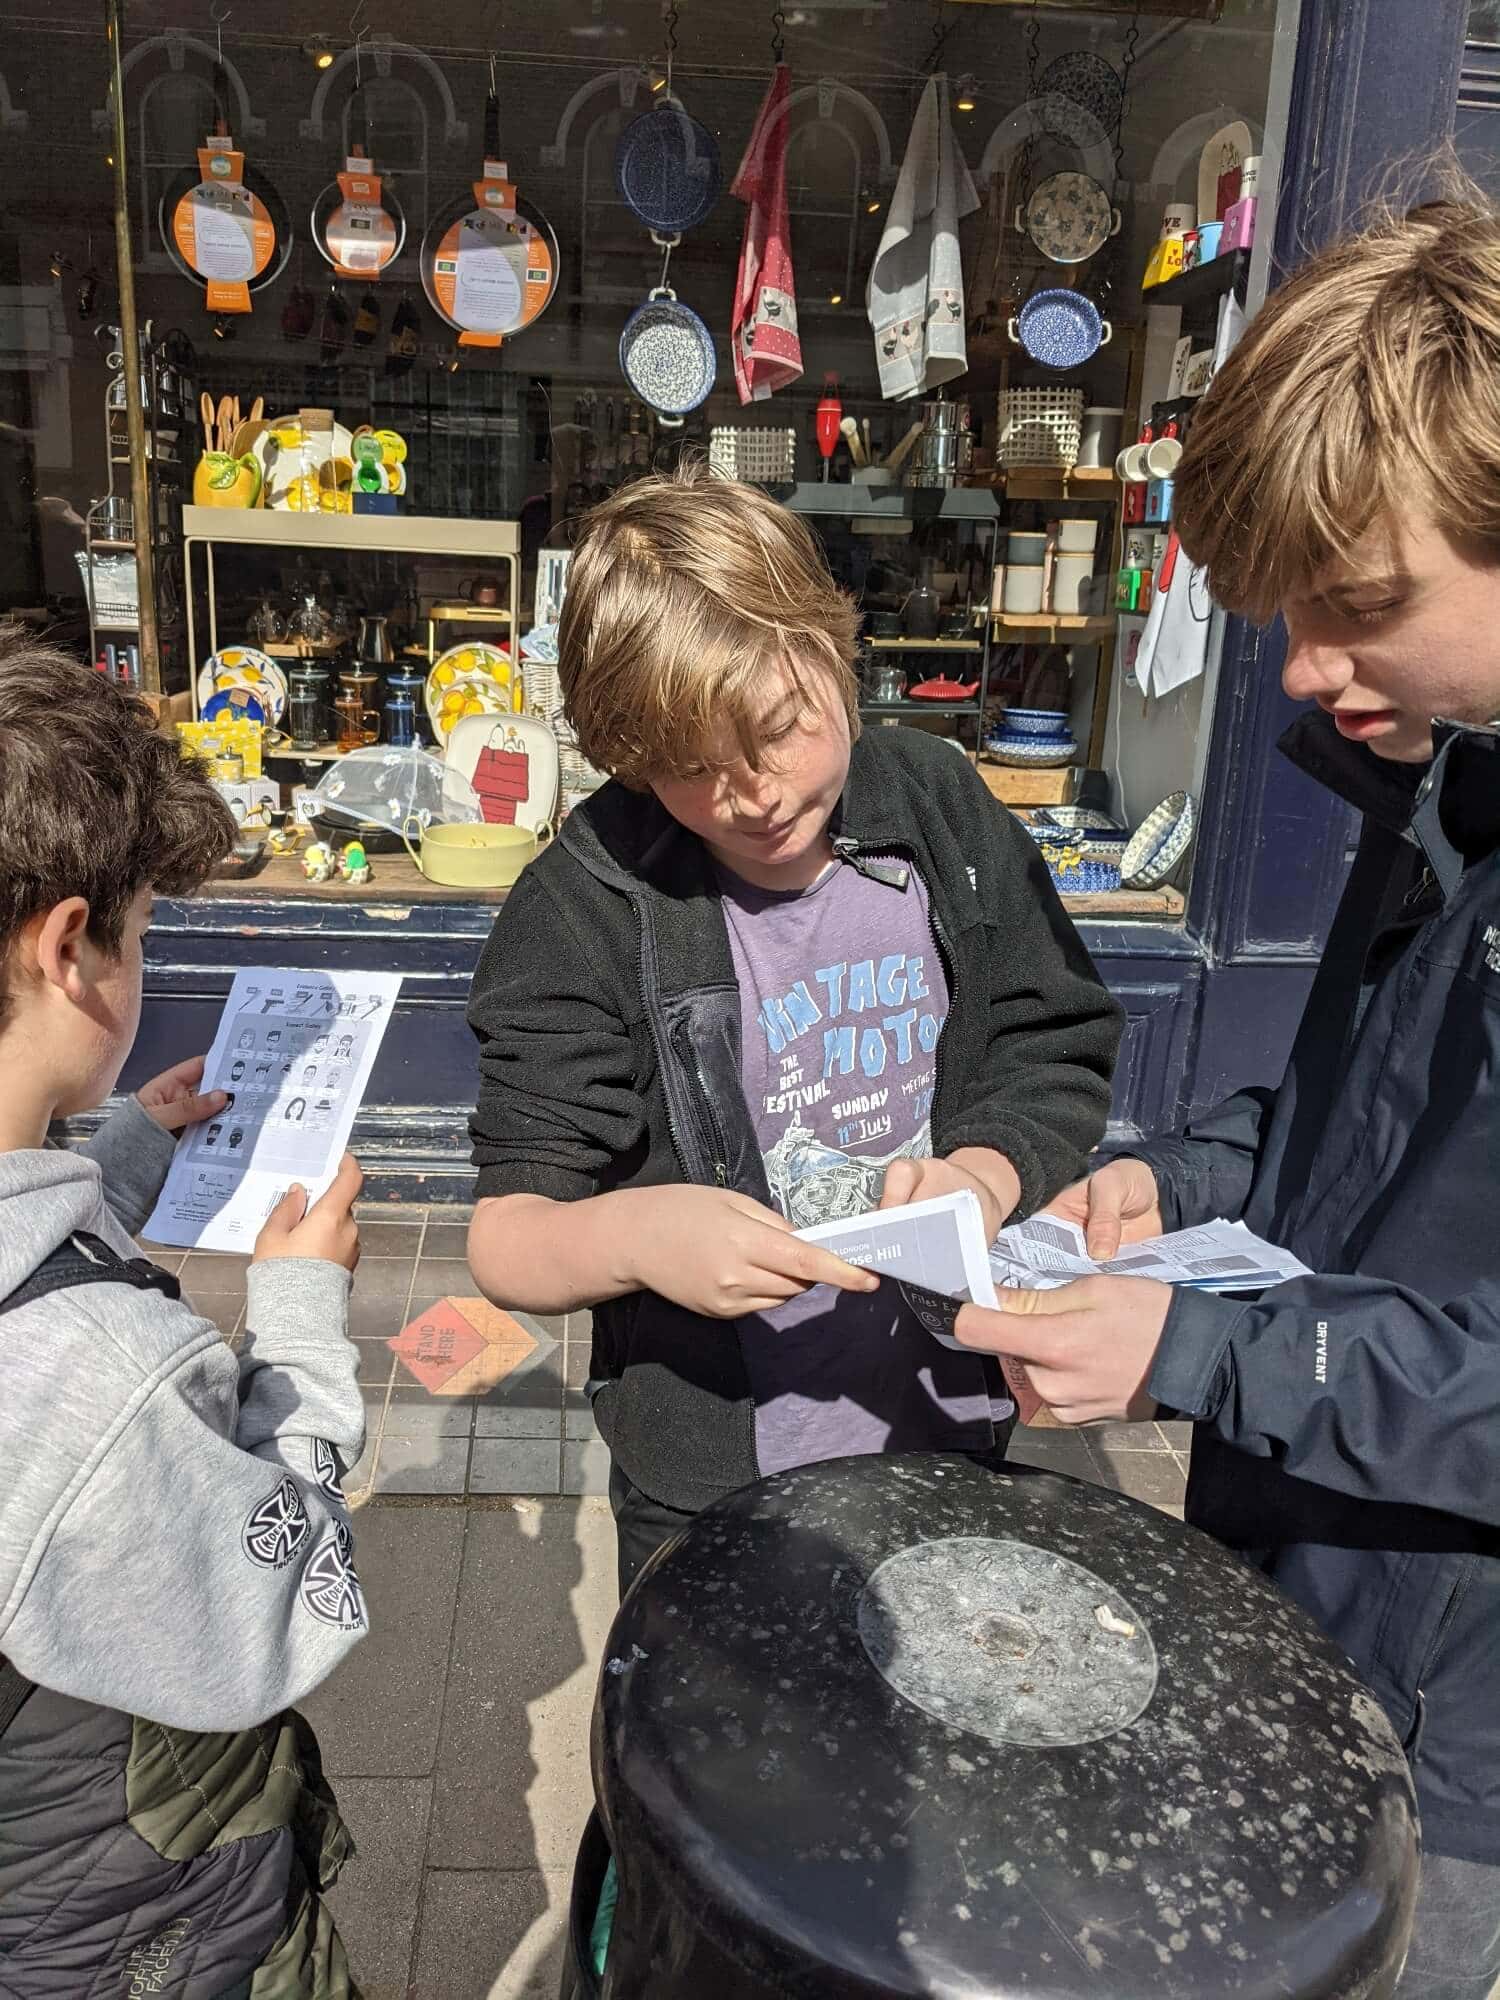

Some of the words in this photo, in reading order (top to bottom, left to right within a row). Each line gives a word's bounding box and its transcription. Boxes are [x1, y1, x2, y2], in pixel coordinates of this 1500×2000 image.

[757, 954, 930, 1053] VINTAGE
[822, 1008, 945, 1077] MOTO
[779, 1069, 804, 1090] BEST
[780, 1055, 799, 1072] THE
[763, 1079, 831, 1115] ESTIVAL
[832, 1088, 889, 1120] SUNDAY
[877, 1243, 902, 1262] Hill
[416, 1324, 435, 1361] STAND
[439, 1328, 456, 1361] HERE
[1315, 1321, 1328, 1384] DRYVENT
[273, 1549, 299, 1571] TRUCK
[146, 1946, 176, 1992] FACE
